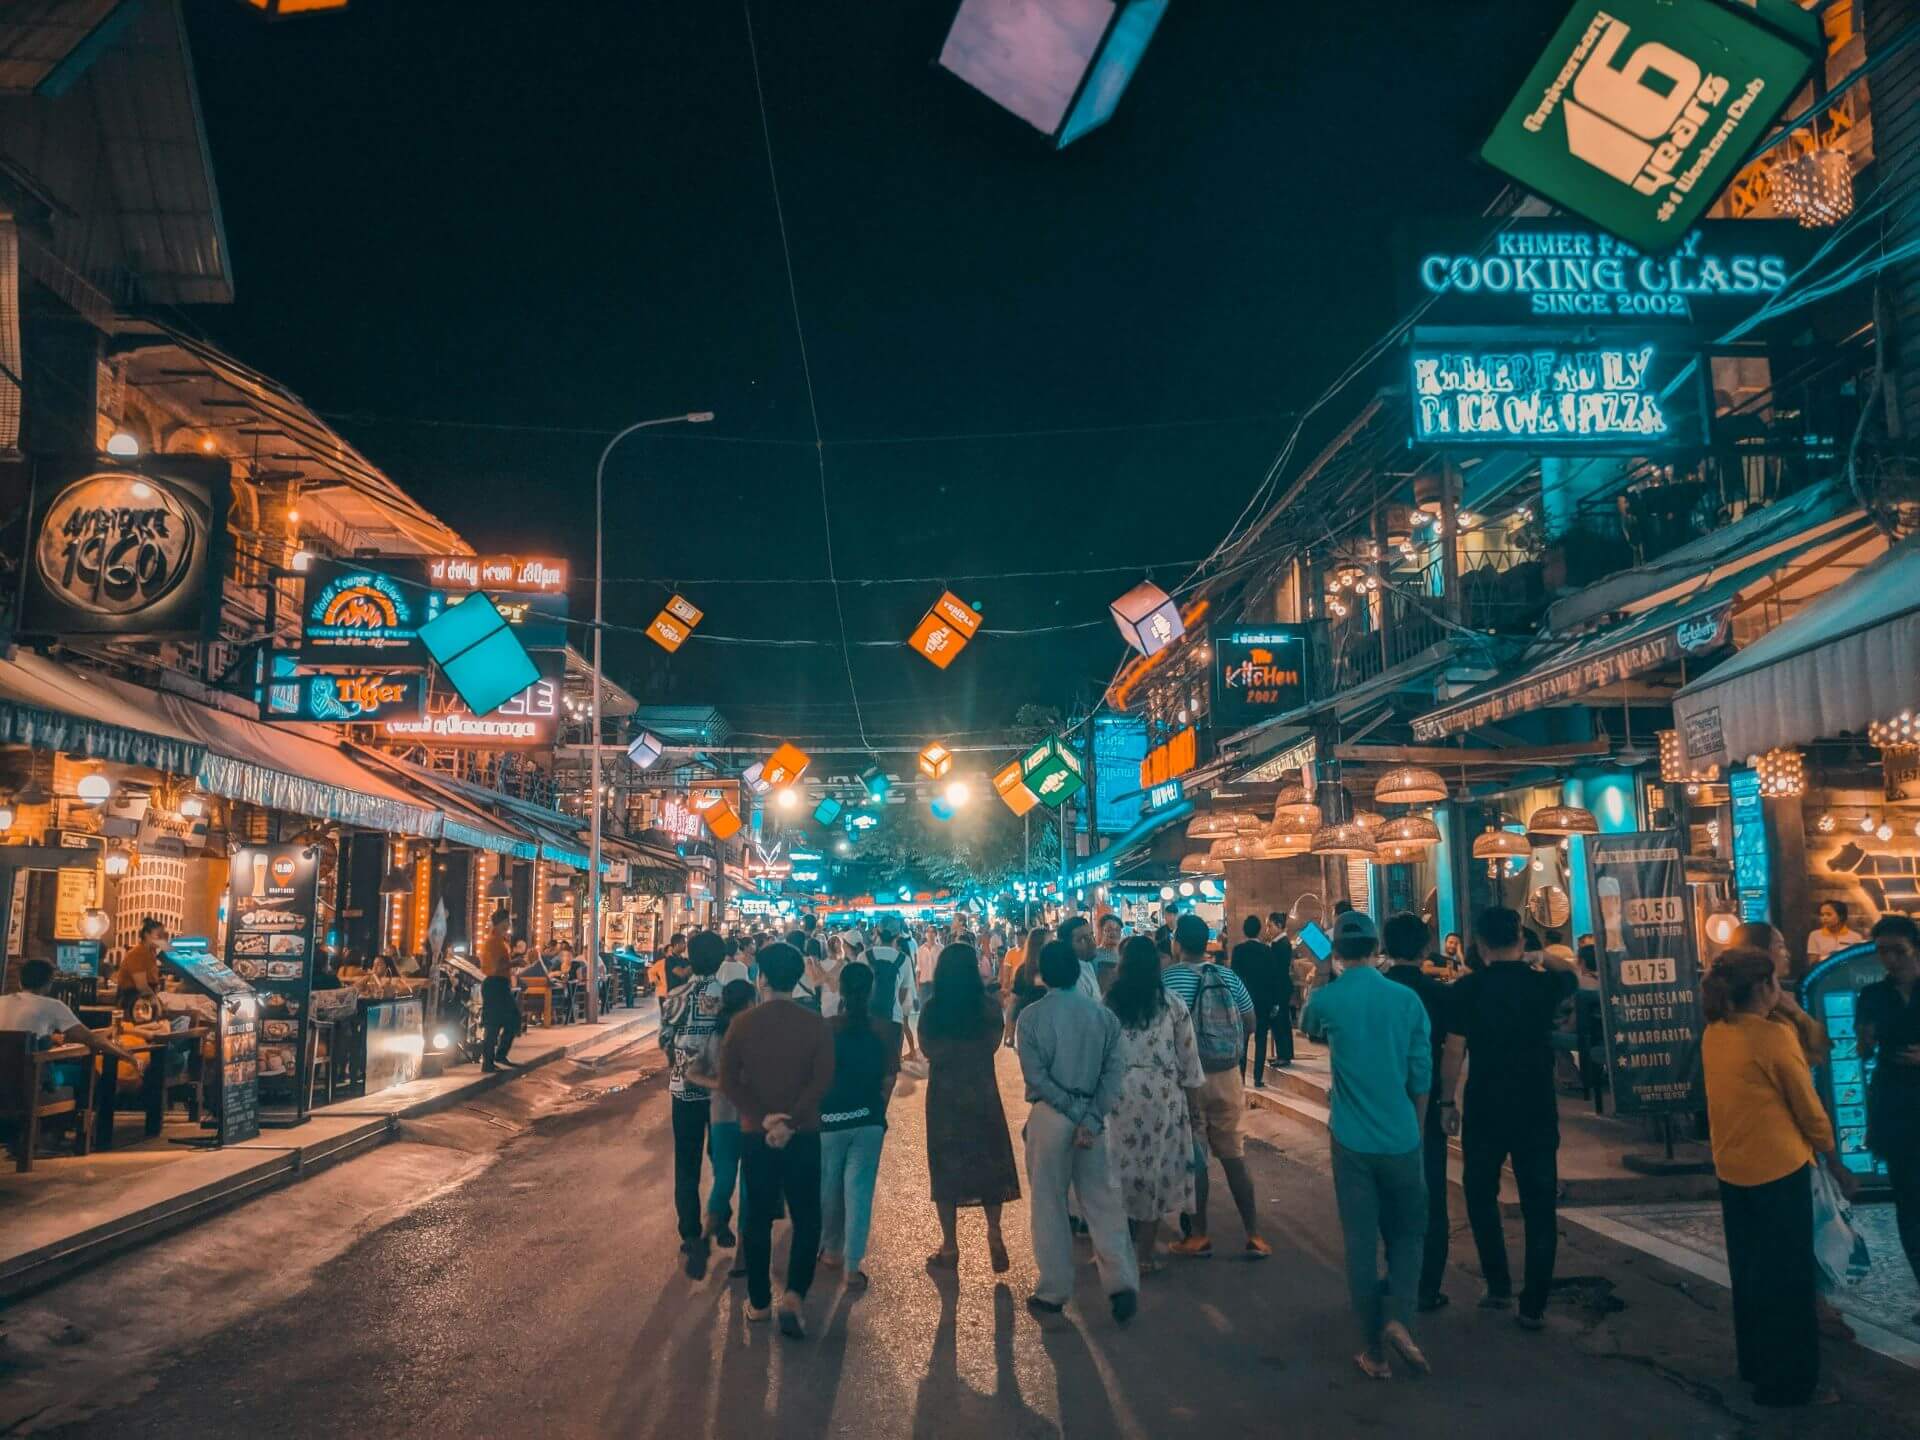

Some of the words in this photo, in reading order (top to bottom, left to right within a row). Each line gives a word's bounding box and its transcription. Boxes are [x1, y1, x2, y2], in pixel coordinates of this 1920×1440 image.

[1523, 10, 1613, 132] Anniversary
[1563, 18, 1701, 187] 16
[1674, 118, 1739, 193] Western
[1727, 77, 1765, 121] Club
[1499, 233, 1594, 257] KHMER
[1599, 230, 1703, 257] FAY
[1422, 256, 1626, 293] COOKING
[1637, 256, 1788, 294] CLASS
[1531, 294, 1612, 315] SINCE
[1617, 294, 1688, 315] 2002
[1415, 354, 1533, 395] KHMER
[1532, 347, 1654, 392] FAMILY
[1419, 394, 1502, 434] BRICK
[1503, 390, 1577, 434] OVEN
[1578, 394, 1667, 434] PIZZA
[61, 533, 168, 602] 1960
[311, 589, 335, 620] World
[944, 601, 975, 628] TEMPLE
[307, 628, 344, 638] Wood
[347, 628, 381, 638] Fired
[924, 627, 952, 654] TEMPLE
[1677, 615, 1719, 648] Carlsberg
[1584, 638, 1668, 686] RESTAURANT
[336, 676, 408, 712] Tiger
[1631, 902, 1676, 921] $0.50
[1634, 926, 1661, 939] DRAFT
[1628, 963, 1668, 981] $1.75
[1623, 993, 1653, 1007] LONG
[1654, 990, 1693, 1005] ISLAND
[1625, 1008, 1651, 1022] ICED
[1652, 1007, 1673, 1021] TEA
[1628, 1028, 1692, 1045] MARGARITA
[1630, 1053, 1671, 1067] MOJITO
